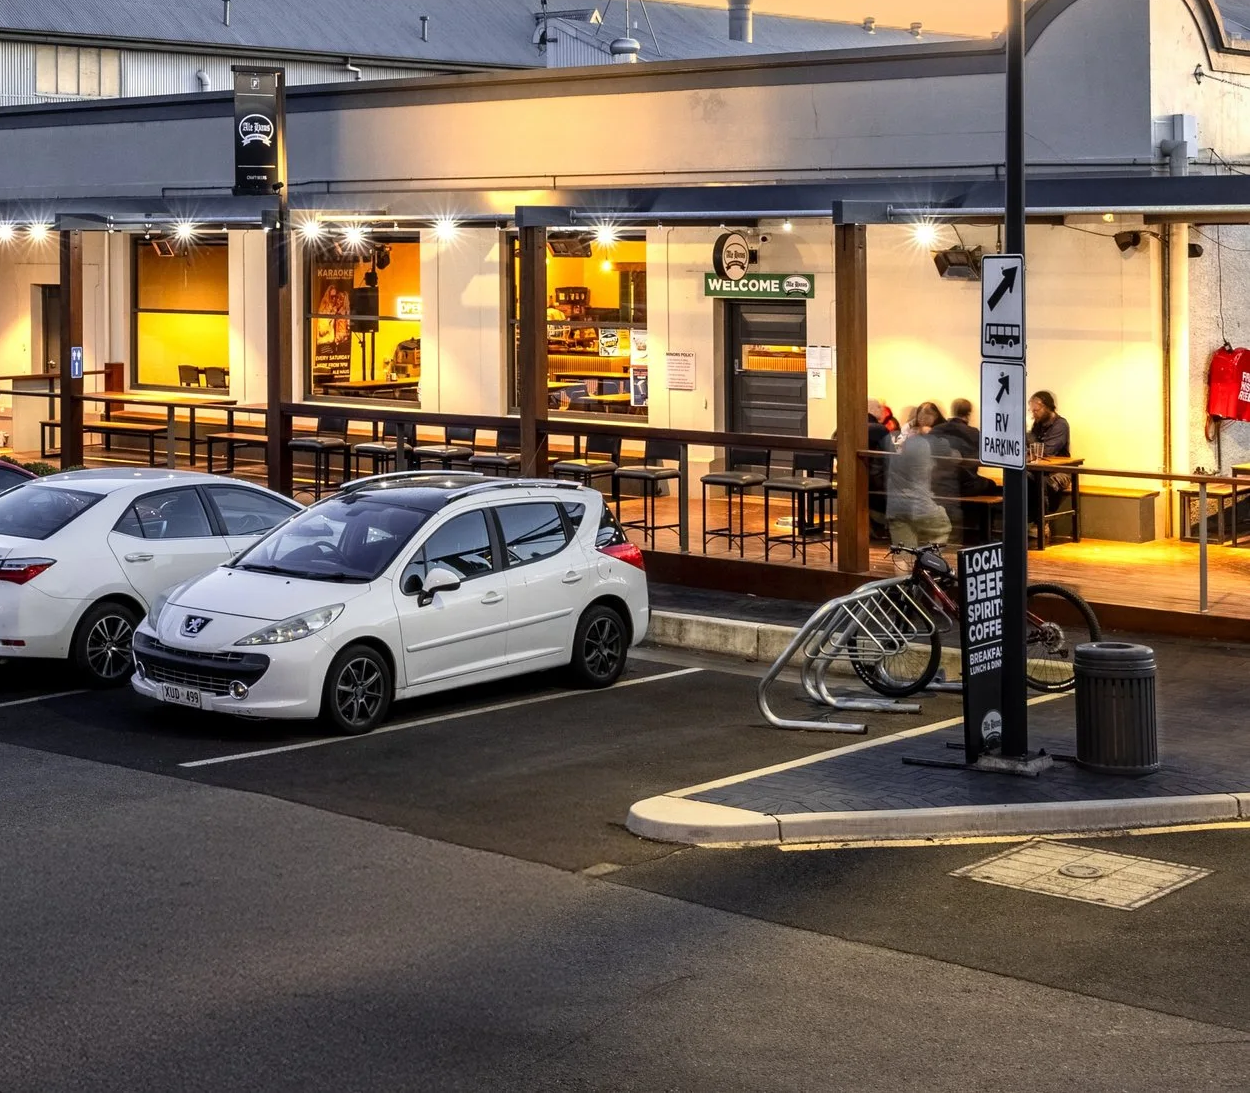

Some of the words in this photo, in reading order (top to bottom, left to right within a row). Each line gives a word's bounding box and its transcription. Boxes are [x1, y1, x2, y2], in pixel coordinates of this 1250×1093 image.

[317, 269, 354, 277] KARAOKE
[708, 279, 780, 292] WELCOME
[401, 302, 420, 314] OPE
[995, 413, 1009, 433] RV
[984, 436, 1020, 457] PARKING
[966, 548, 1003, 575] LOCAL
[968, 598, 1002, 623] SPIRIT
[968, 618, 1002, 642] COFFE
[969, 646, 1002, 665] BREAKFA
[970, 662, 987, 676] LUNCH
[164, 686, 180, 699] XUD
[186, 690, 199, 703] 499
